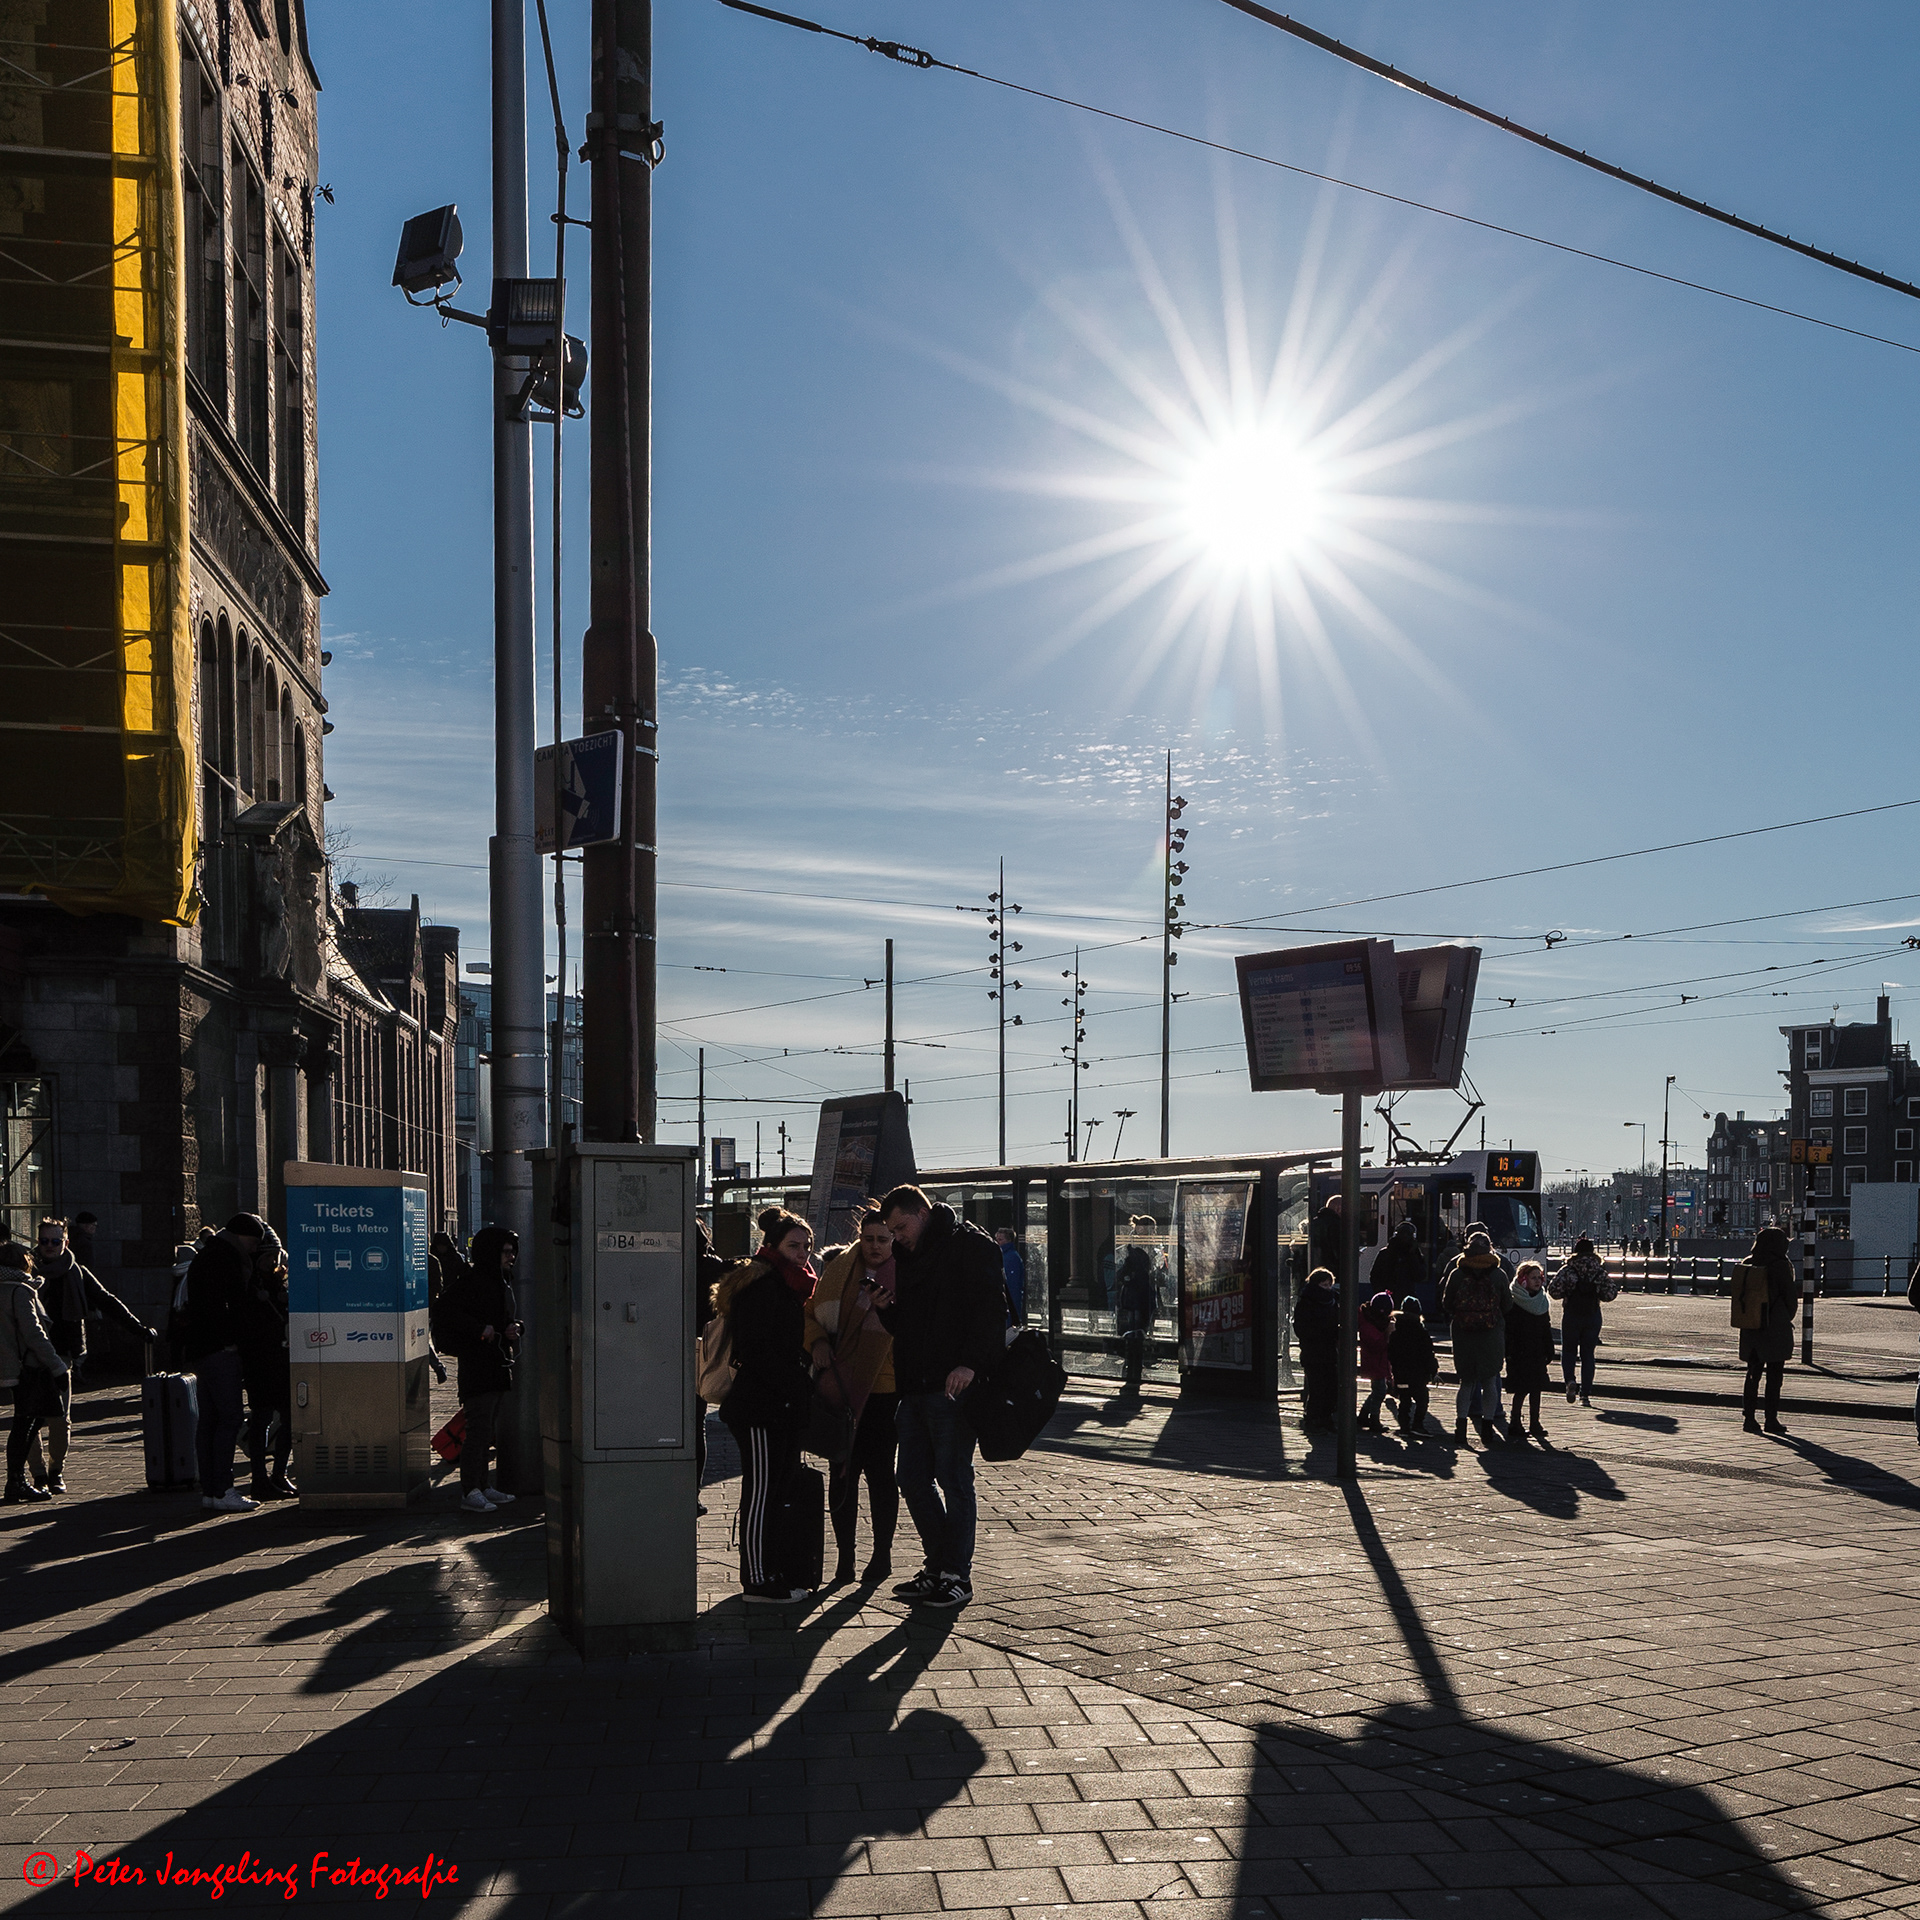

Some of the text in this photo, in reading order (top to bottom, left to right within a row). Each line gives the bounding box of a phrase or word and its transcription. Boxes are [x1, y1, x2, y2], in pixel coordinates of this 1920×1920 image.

[537, 735, 614, 762] CAMRA TOEZICHT
[1248, 973, 1294, 987] Vertrek trams
[1794, 1147, 1802, 1160] 3
[1814, 1152, 1820, 1162] 3
[1498, 1156, 1509, 1172] 16
[1756, 1181, 1768, 1193] M
[314, 1203, 374, 1218] Tickets
[300, 1223, 389, 1233] Tram Bus Metro
[607, 1235, 634, 1249] DB4
[1195, 1275, 1241, 1298] ACTIEWEEK!
[1192, 1299, 1221, 1326] PIZZA
[370, 1332, 394, 1341] GVB
